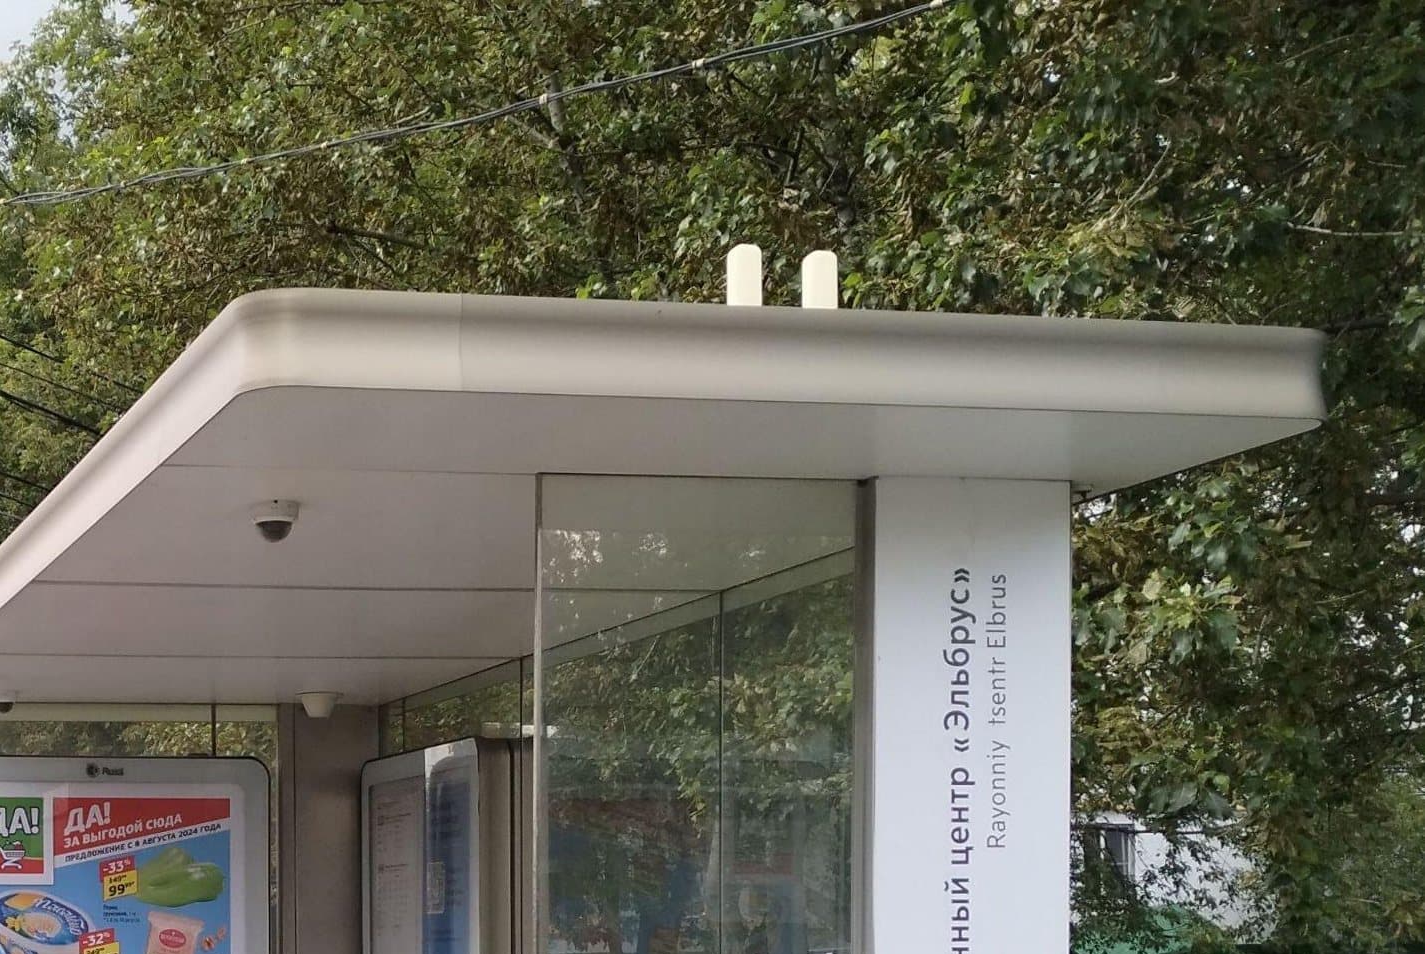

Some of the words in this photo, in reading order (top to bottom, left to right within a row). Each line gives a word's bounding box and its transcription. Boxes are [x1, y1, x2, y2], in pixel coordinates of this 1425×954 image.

[986, 574, 1007, 648] Elbrus
[943, 568, 976, 752] «Эльбрус»
[988, 657, 1006, 725] tsentr
[63, 802, 111, 836] ДА!
[951, 767, 975, 865] центр
[986, 740, 1010, 848] Rayonniy
[63, 837, 80, 848] ЗА
[82, 819, 143, 845] ВЫГОДОЙ
[146, 813, 183, 830] СЮДА
[65, 843, 126, 863] ПРЕДЛОЖЕНИЕ
[142, 834, 176, 846] АВГУСТА
[178, 827, 198, 838] 2024
[200, 823, 222, 833] ГОДА
